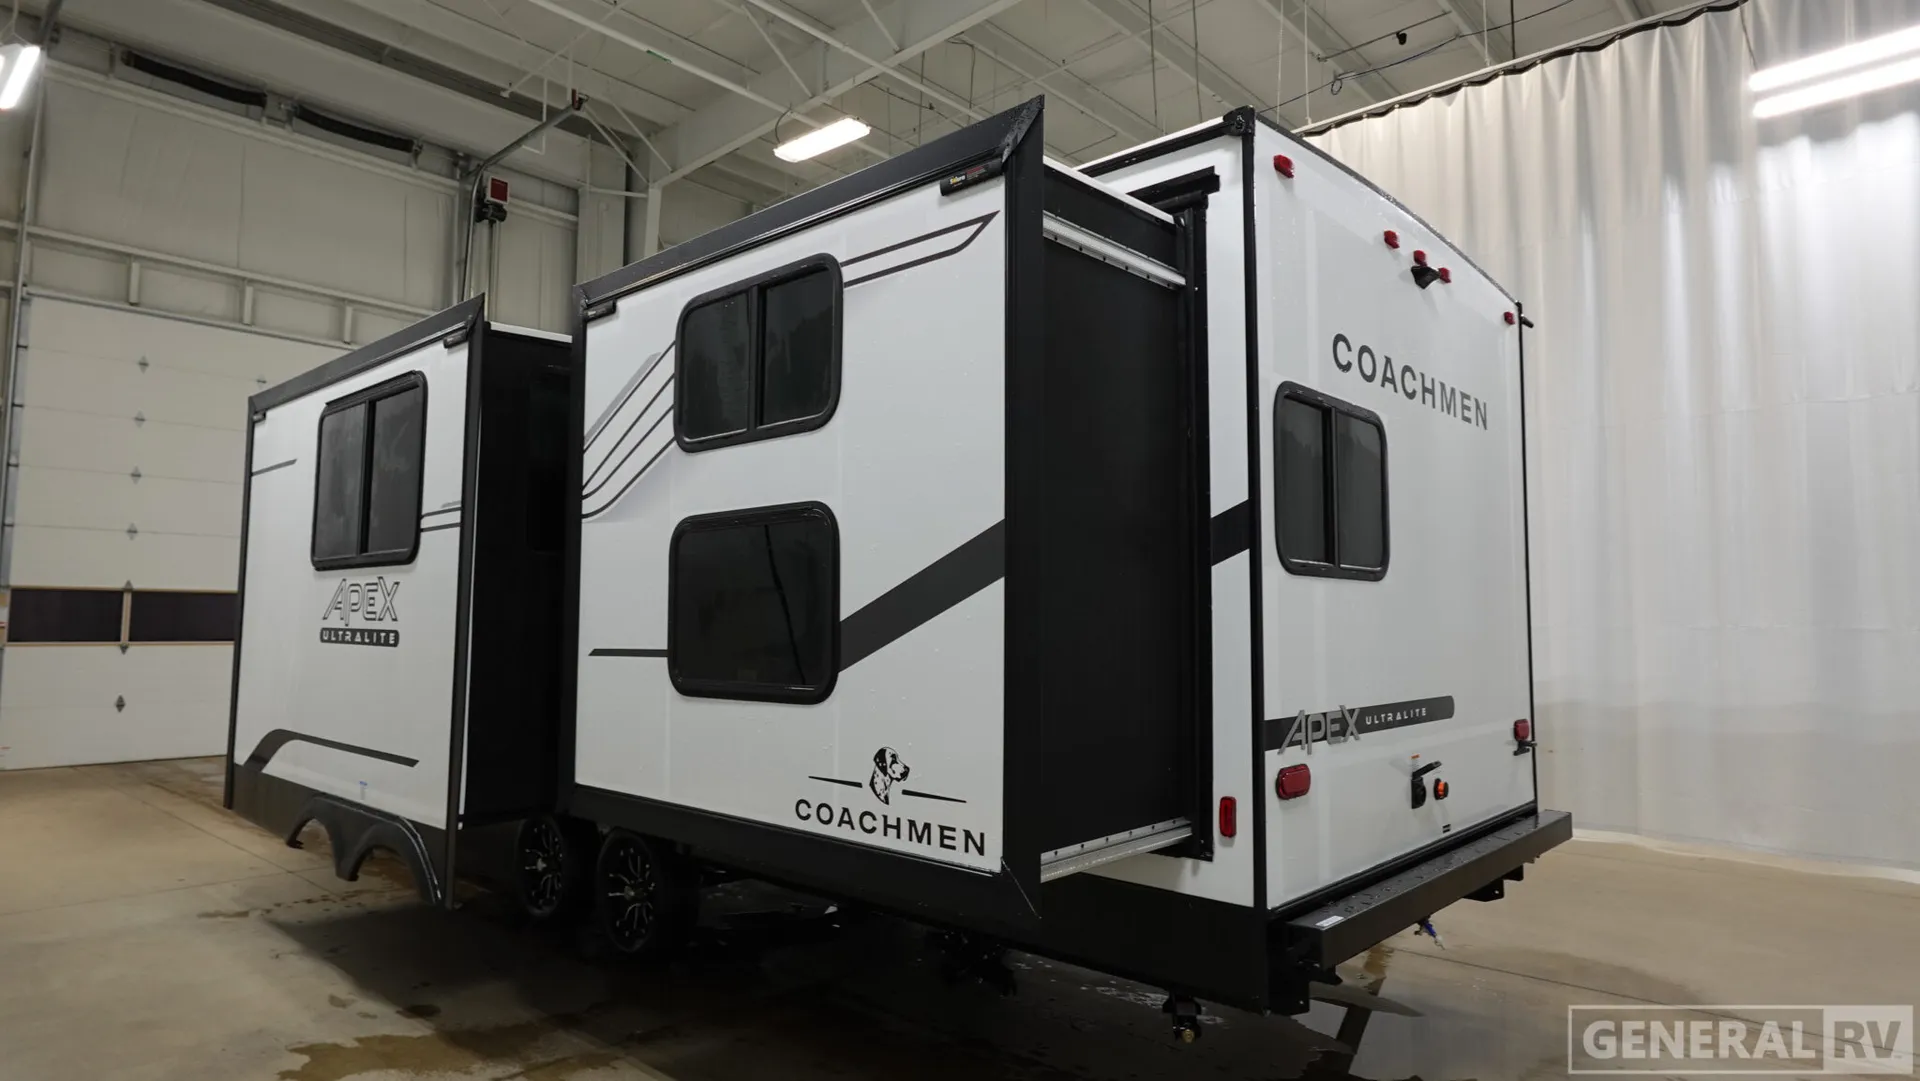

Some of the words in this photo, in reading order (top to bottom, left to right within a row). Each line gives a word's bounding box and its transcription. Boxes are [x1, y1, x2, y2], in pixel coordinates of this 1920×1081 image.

[1332, 333, 1488, 430] COACHMEN
[322, 576, 400, 627] APEX
[322, 630, 396, 644] ULTRALITE
[1277, 705, 1361, 755] APEX
[1365, 707, 1427, 725] ULTRALITE
[795, 799, 985, 856] COACHMEN
